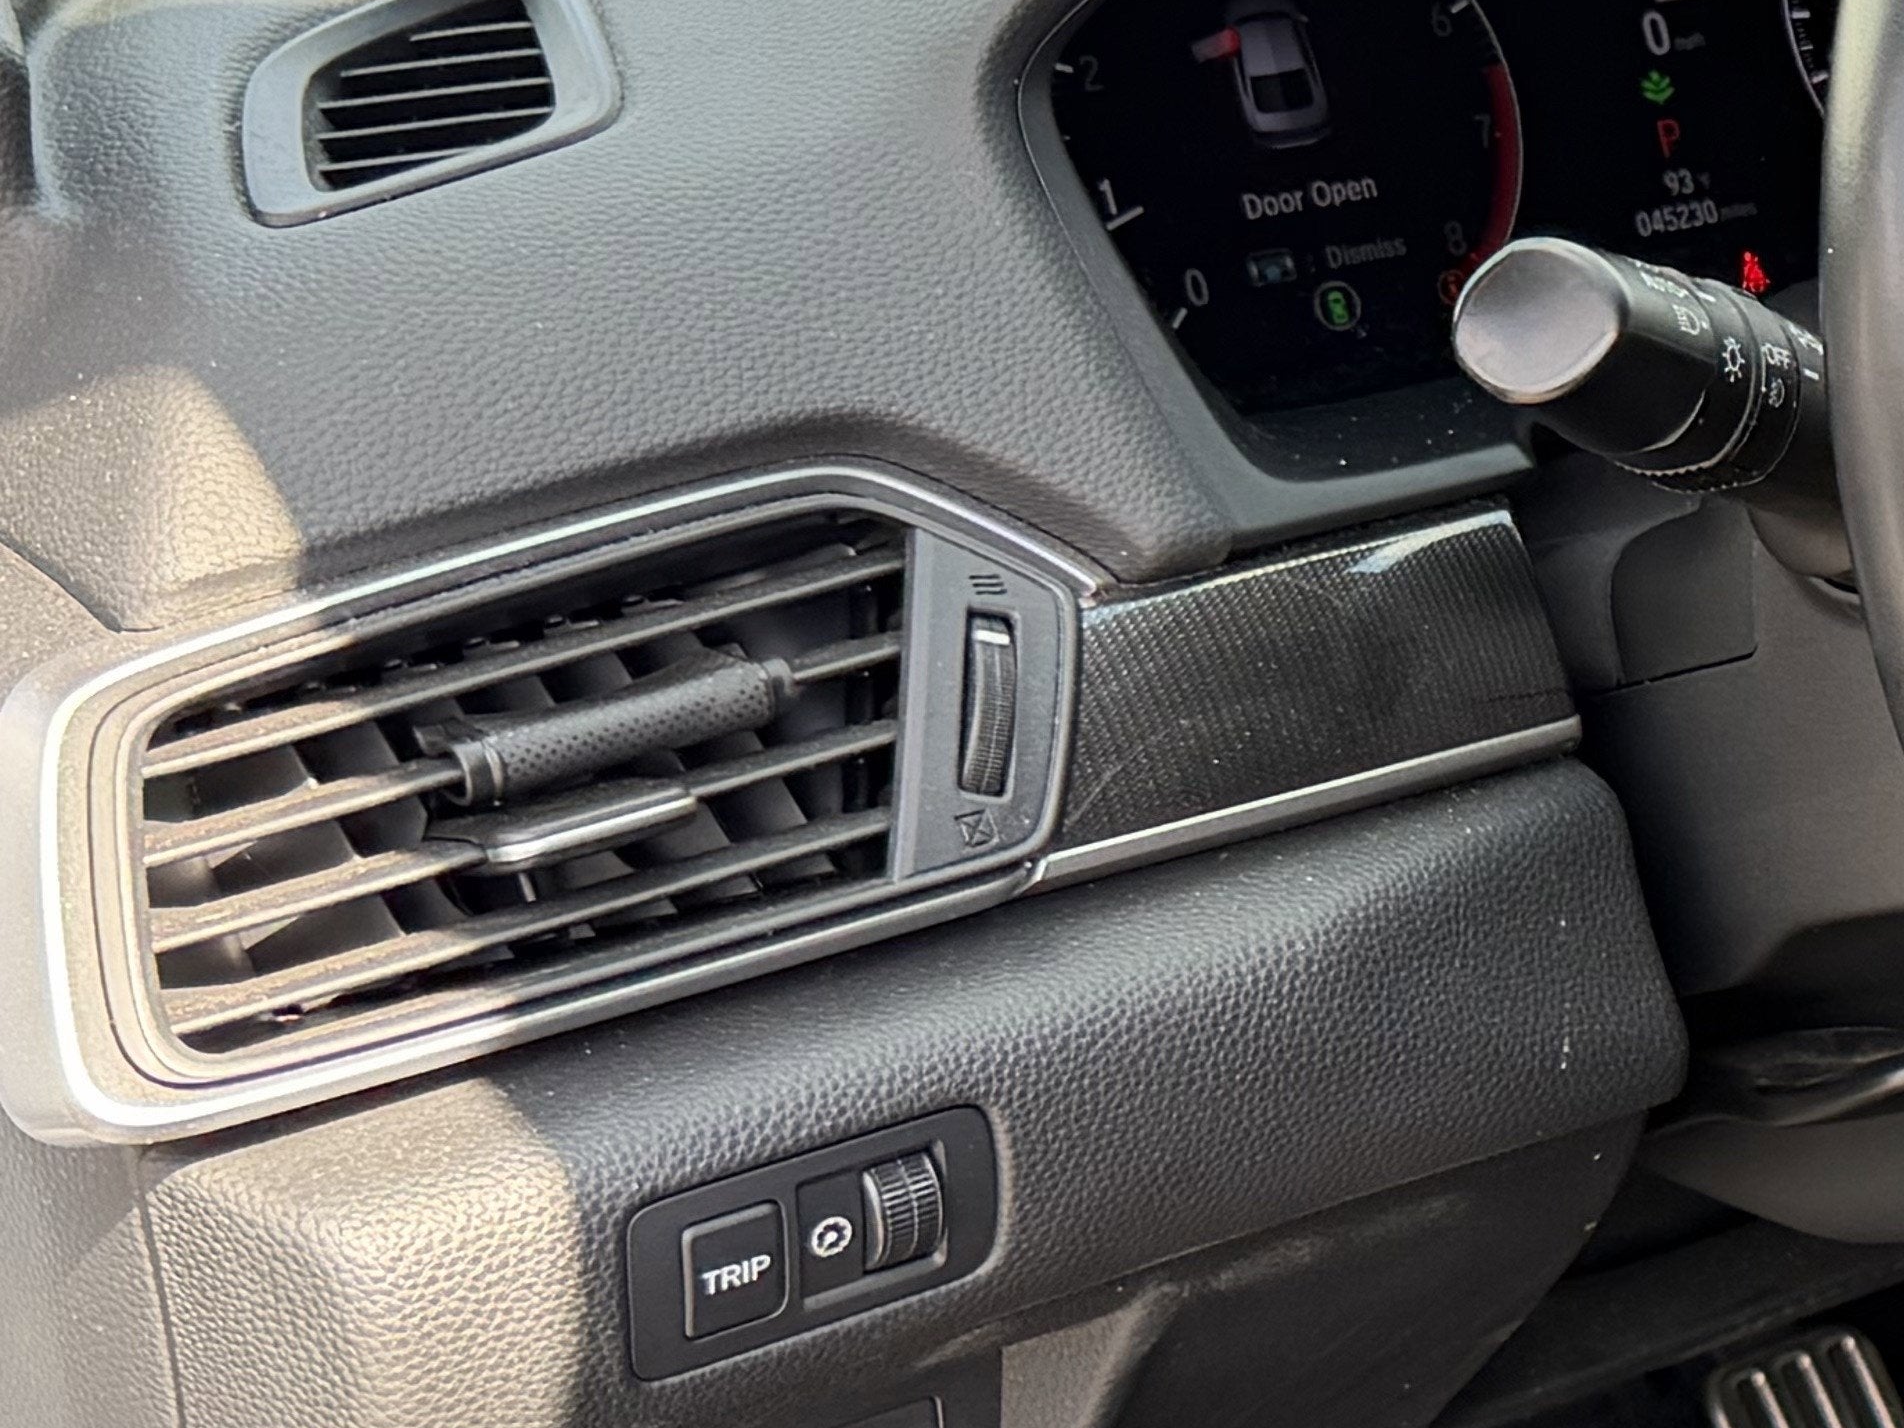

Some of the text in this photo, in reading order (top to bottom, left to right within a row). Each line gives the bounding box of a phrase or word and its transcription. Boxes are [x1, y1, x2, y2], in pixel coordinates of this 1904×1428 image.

[1430, 0, 1454, 38] 6
[1641, 9, 1671, 57] 0
[1079, 55, 1103, 92] 2
[1472, 112, 1492, 148] 7
[1655, 115, 1681, 159] P
[1097, 177, 1119, 216] 1
[1241, 175, 1379, 221] Door Open
[1662, 166, 1696, 198] 93
[1634, 196, 1720, 238] 045230
[1325, 233, 1409, 270] Dismiss
[1443, 218, 1469, 256] 8
[1183, 267, 1210, 308] 0
[1765, 342, 1792, 370] OFF
[702, 1252, 772, 1296] TRIP
